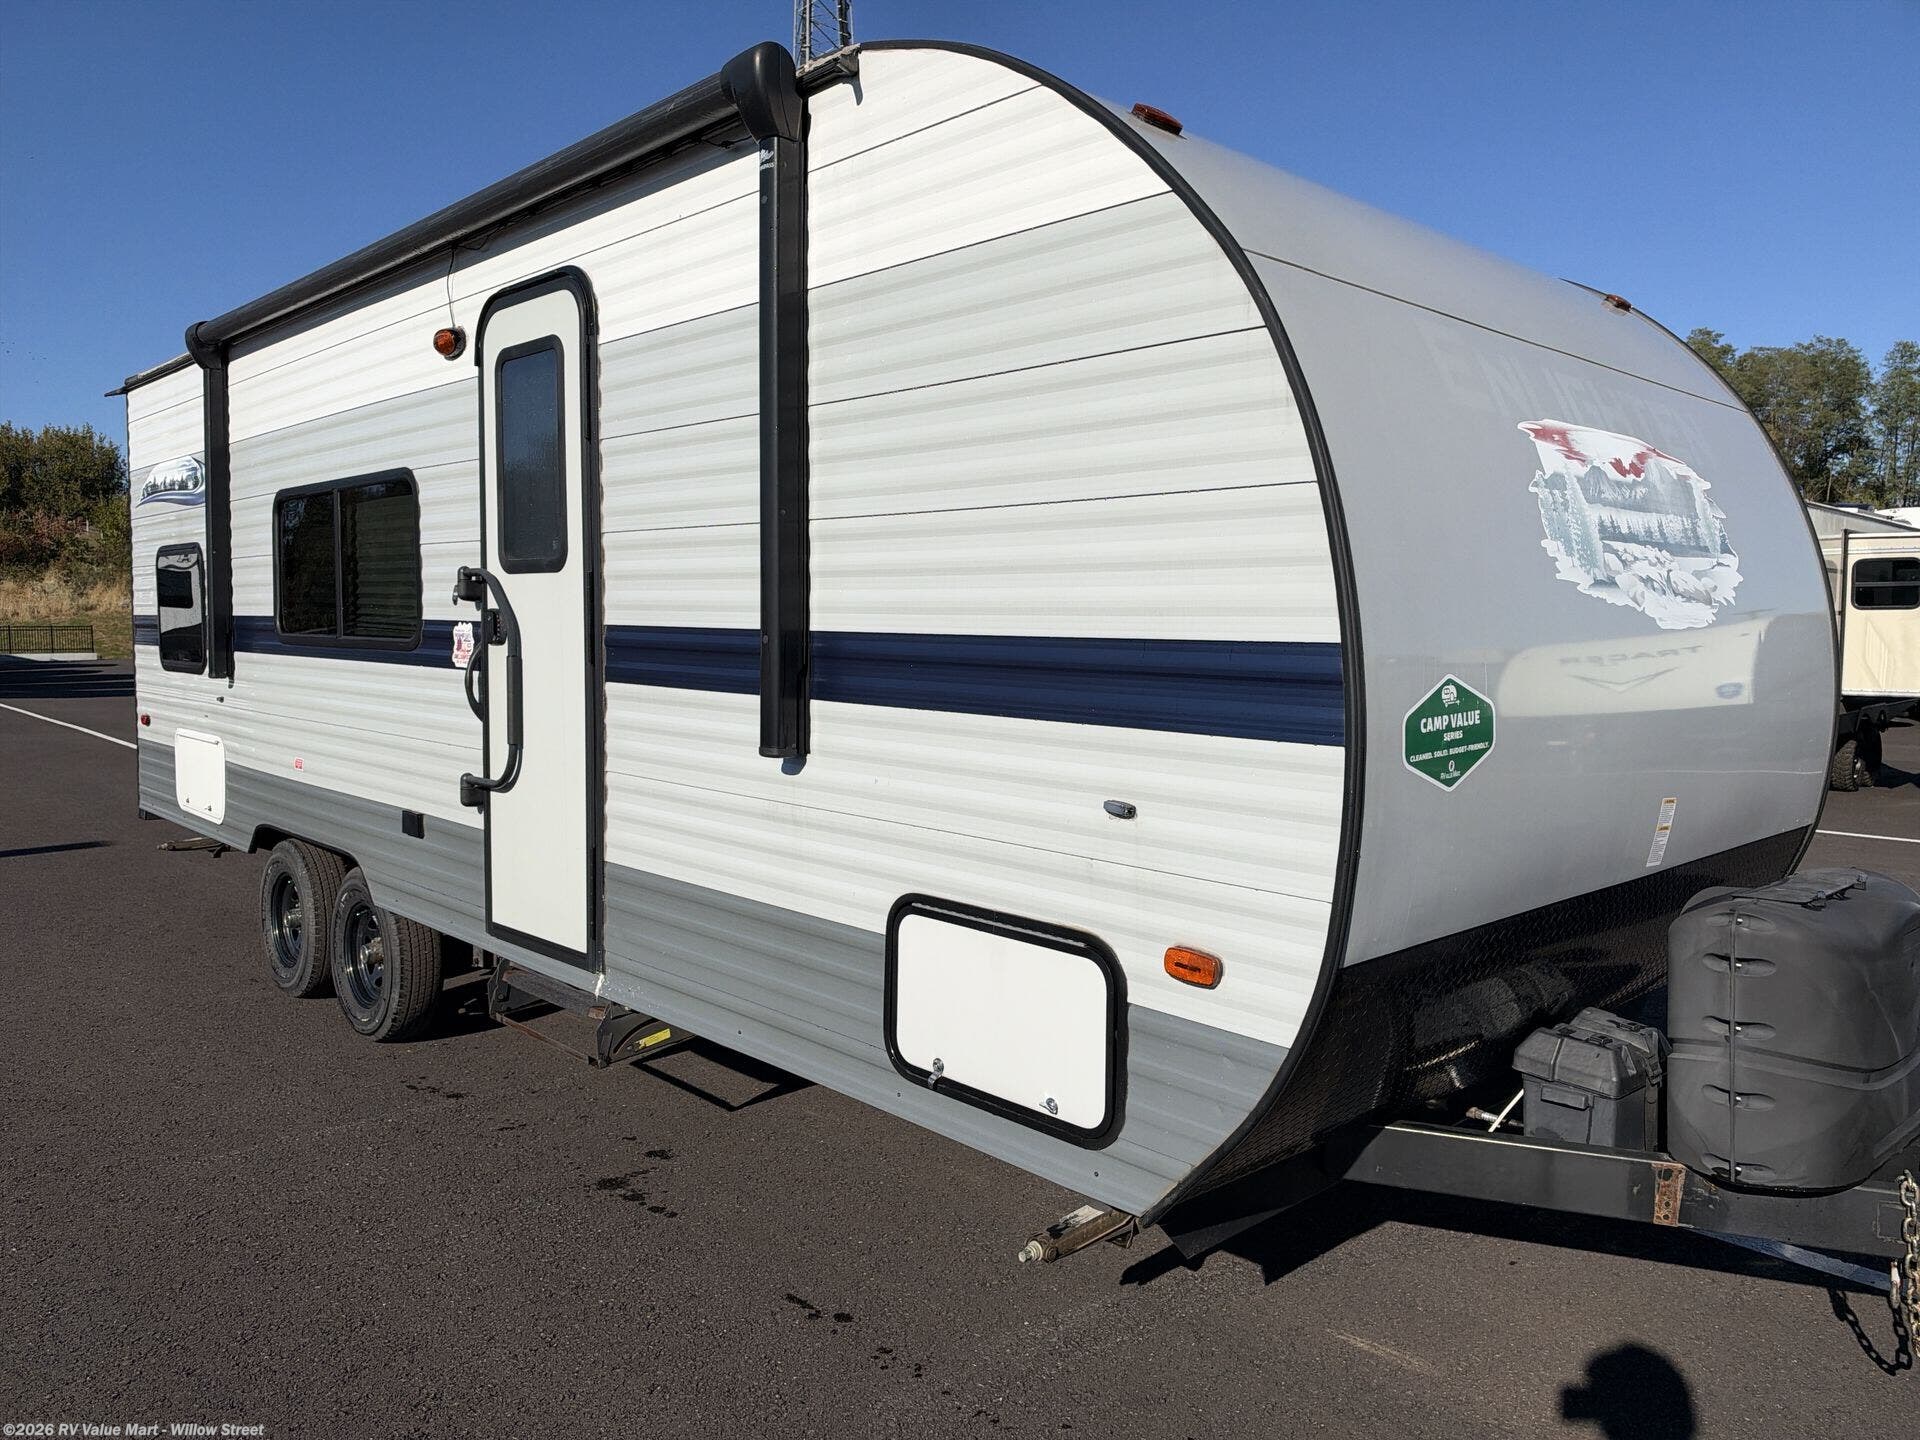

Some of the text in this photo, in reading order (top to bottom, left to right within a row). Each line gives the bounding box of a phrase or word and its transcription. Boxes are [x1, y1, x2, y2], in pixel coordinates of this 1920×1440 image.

[1420, 710, 1480, 733] CAMP VALUE
[1443, 730, 1463, 742] SERIES
